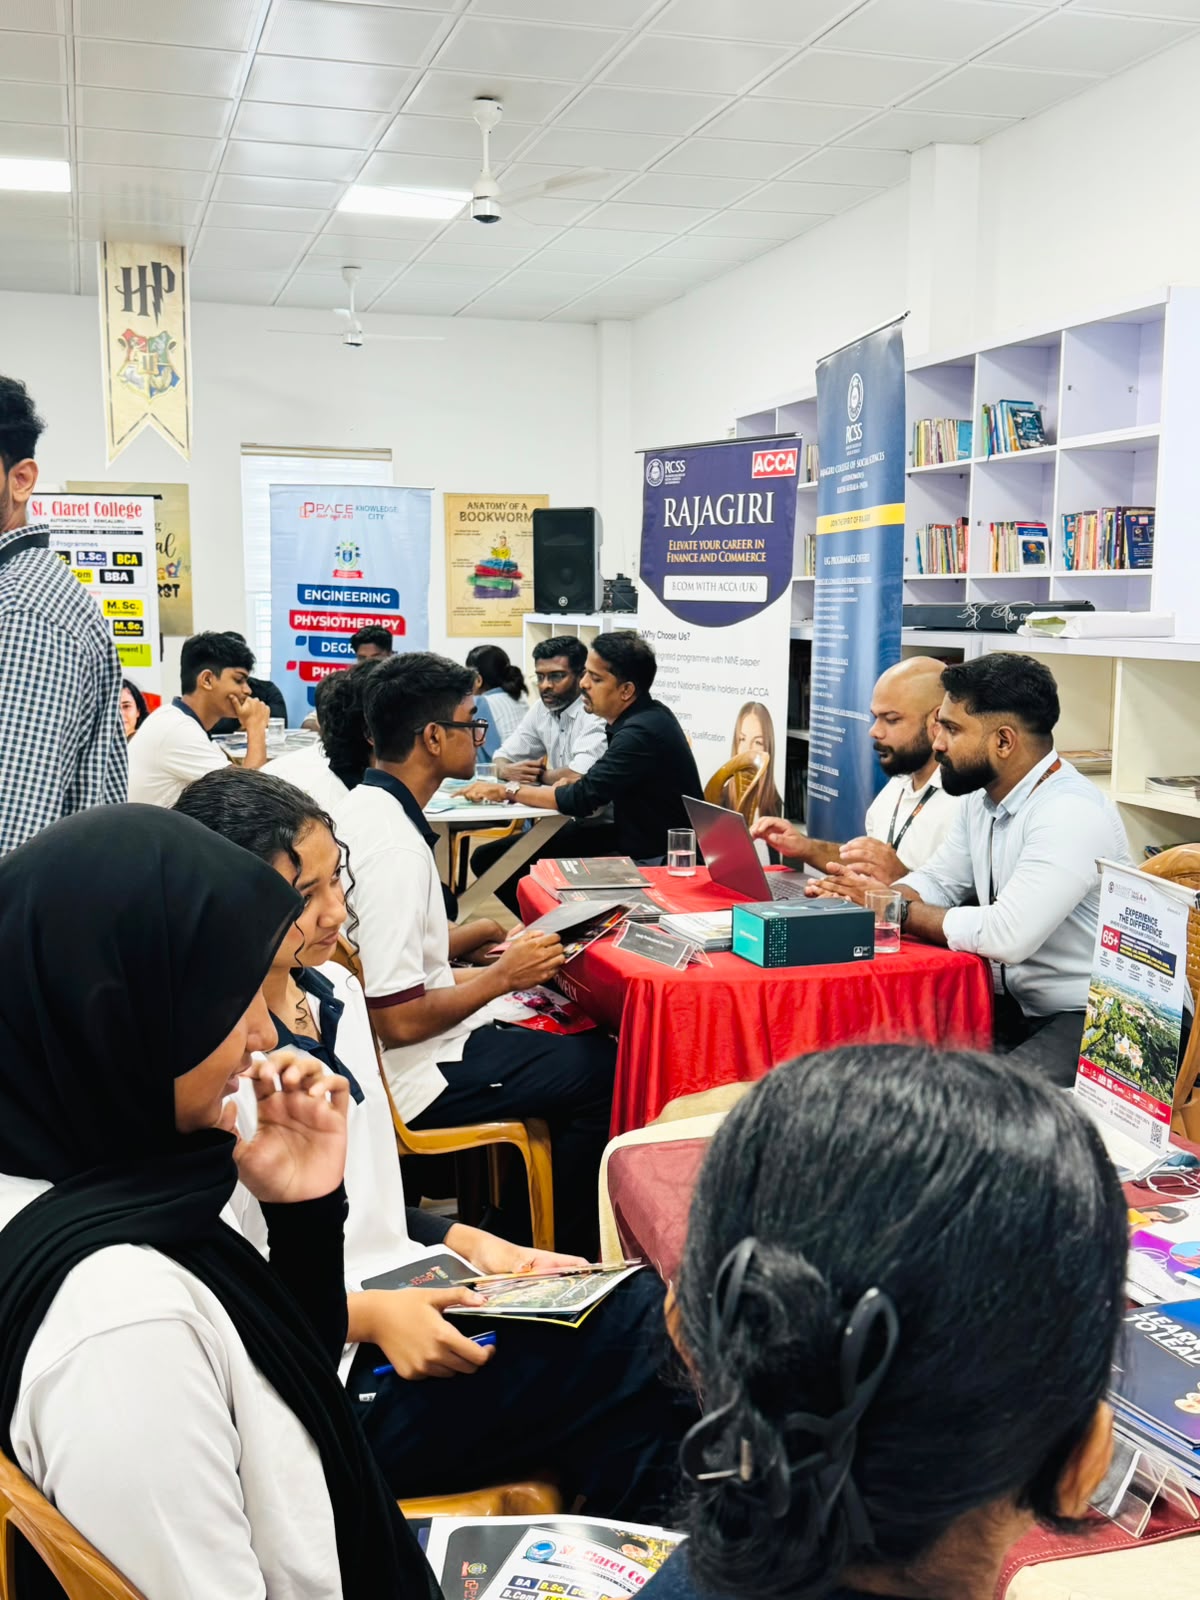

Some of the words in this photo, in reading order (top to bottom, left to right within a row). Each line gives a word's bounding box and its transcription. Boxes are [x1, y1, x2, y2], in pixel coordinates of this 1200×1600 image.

[114, 261, 176, 328] HP
[664, 459, 686, 474] RCSS
[753, 453, 795, 473] ACCA
[31, 501, 47, 517] St.
[51, 501, 89, 517] Claret
[94, 501, 143, 520] College
[316, 504, 353, 514] PACE
[355, 505, 398, 513] KNOWLEDGE
[467, 502, 507, 510] ANATOMY
[508, 502, 520, 510] OF
[459, 511, 534, 523] BOOKWORM
[663, 492, 775, 536] RAJAGIRI
[669, 540, 698, 551] ELEVATE
[699, 540, 721, 550] YOUR
[722, 539, 753, 550] CAREER
[755, 539, 765, 549] IN
[78, 552, 106, 561] B.Sc.
[116, 554, 139, 565] BCA
[666, 552, 699, 563] FINANCE
[700, 552, 718, 562] AND
[718, 551, 767, 562] COMMERCE
[104, 572, 129, 582] BBA
[695, 581, 717, 592] WITH
[717, 581, 738, 592] ACCA
[739, 581, 758, 593] (UK)
[304, 589, 391, 604] ENGINEERING
[294, 615, 400, 631] PHYSIOTHERAPY
[641, 630, 656, 641] Why
[657, 631, 677, 640] Choose
[678, 632, 691, 640] Us?
[321, 642, 356, 654] DEGR
[677, 654, 710, 664] programme
[711, 655, 723, 664] with
[724, 657, 739, 666] NINE
[739, 659, 760, 667] paper
[667, 680, 677, 689] and
[678, 681, 701, 691] National
[702, 683, 716, 692] Rank
[718, 684, 739, 695] holders
[740, 686, 747, 695] of
[747, 687, 769, 697] ACCA
[692, 730, 726, 743] qualification
[1125, 906, 1159, 928] EXPERIENCE
[1118, 913, 1130, 925] THE
[1129, 917, 1163, 939] DIFFERENCE
[1102, 929, 1119, 947] 65+
[1121, 1313, 1158, 1332] TO
[514, 1577, 532, 1588] BA
[539, 1580, 566, 1594] B.Sc.
